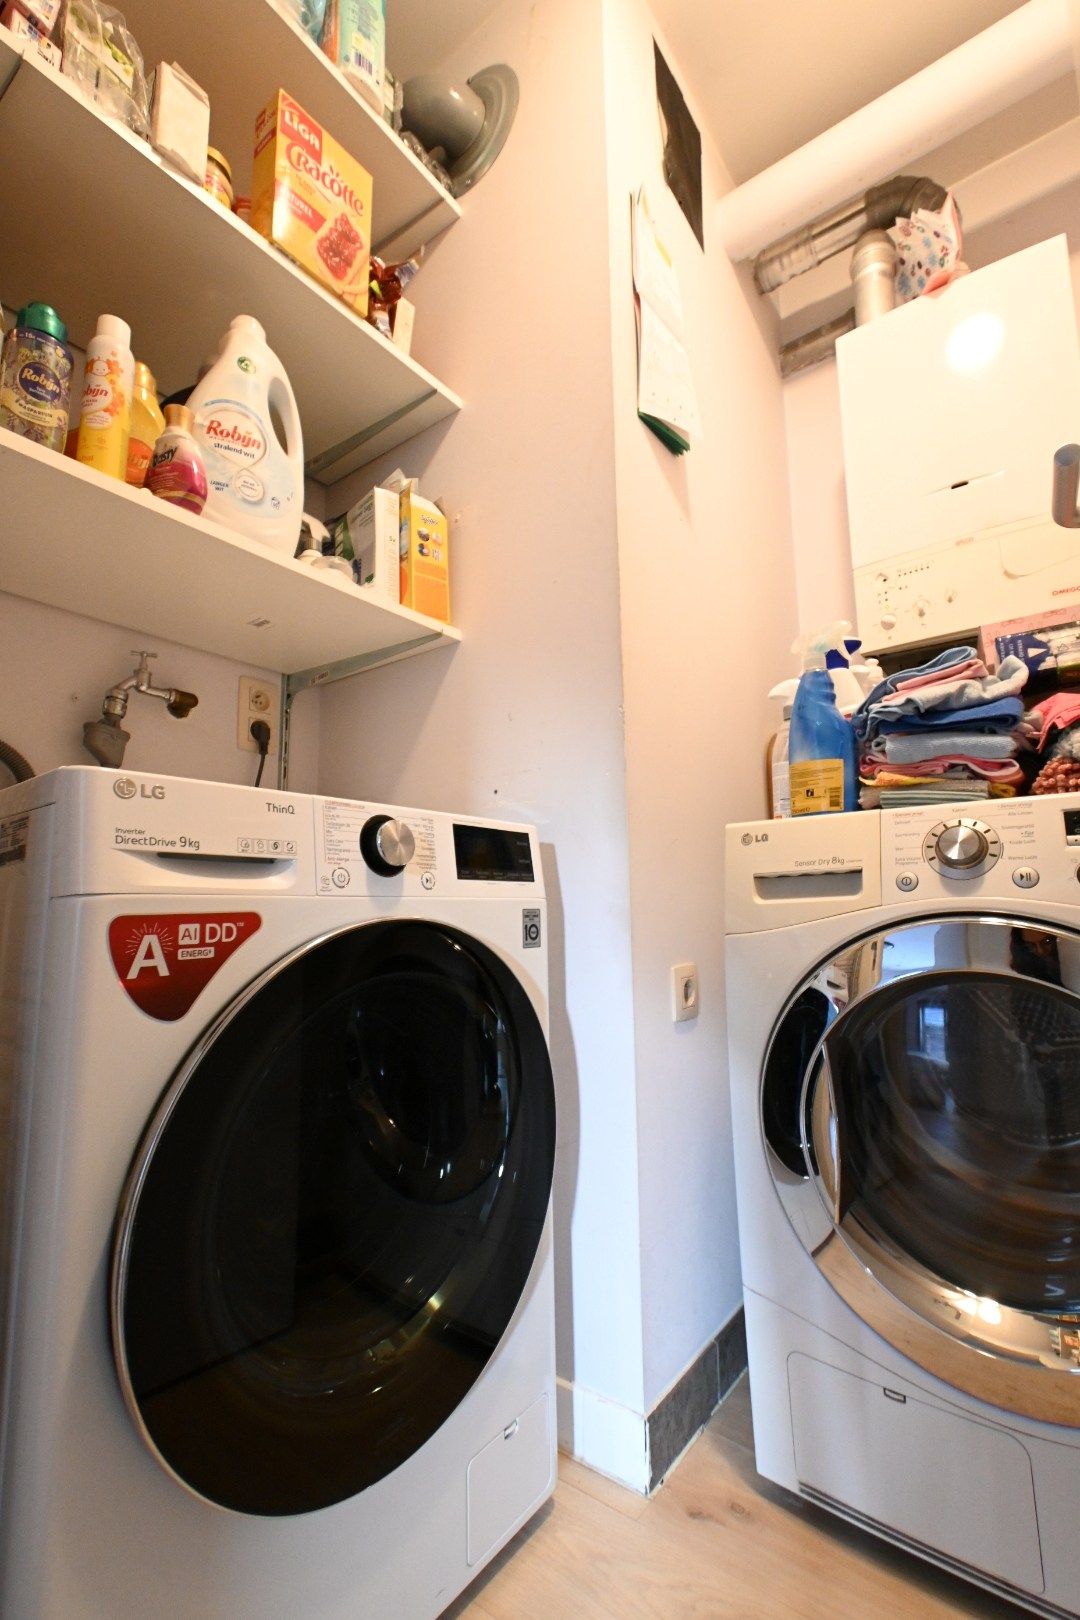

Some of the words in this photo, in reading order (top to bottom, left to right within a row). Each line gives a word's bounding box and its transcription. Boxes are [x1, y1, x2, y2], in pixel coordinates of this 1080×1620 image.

[22, 366, 60, 394] Robijn
[206, 419, 262, 450] Robijn
[213, 441, 243, 456] stralend
[243, 450, 256, 460] wit
[140, 783, 166, 800] LG
[265, 802, 295, 815] ThinQ
[115, 827, 146, 835] Inverter
[755, 833, 769, 843] LG
[794, 859, 816, 867] Sensor
[818, 857, 830, 866] Dry
[180, 926, 199, 942] AI
[525, 924, 539, 942] 10
[126, 934, 170, 980] A
